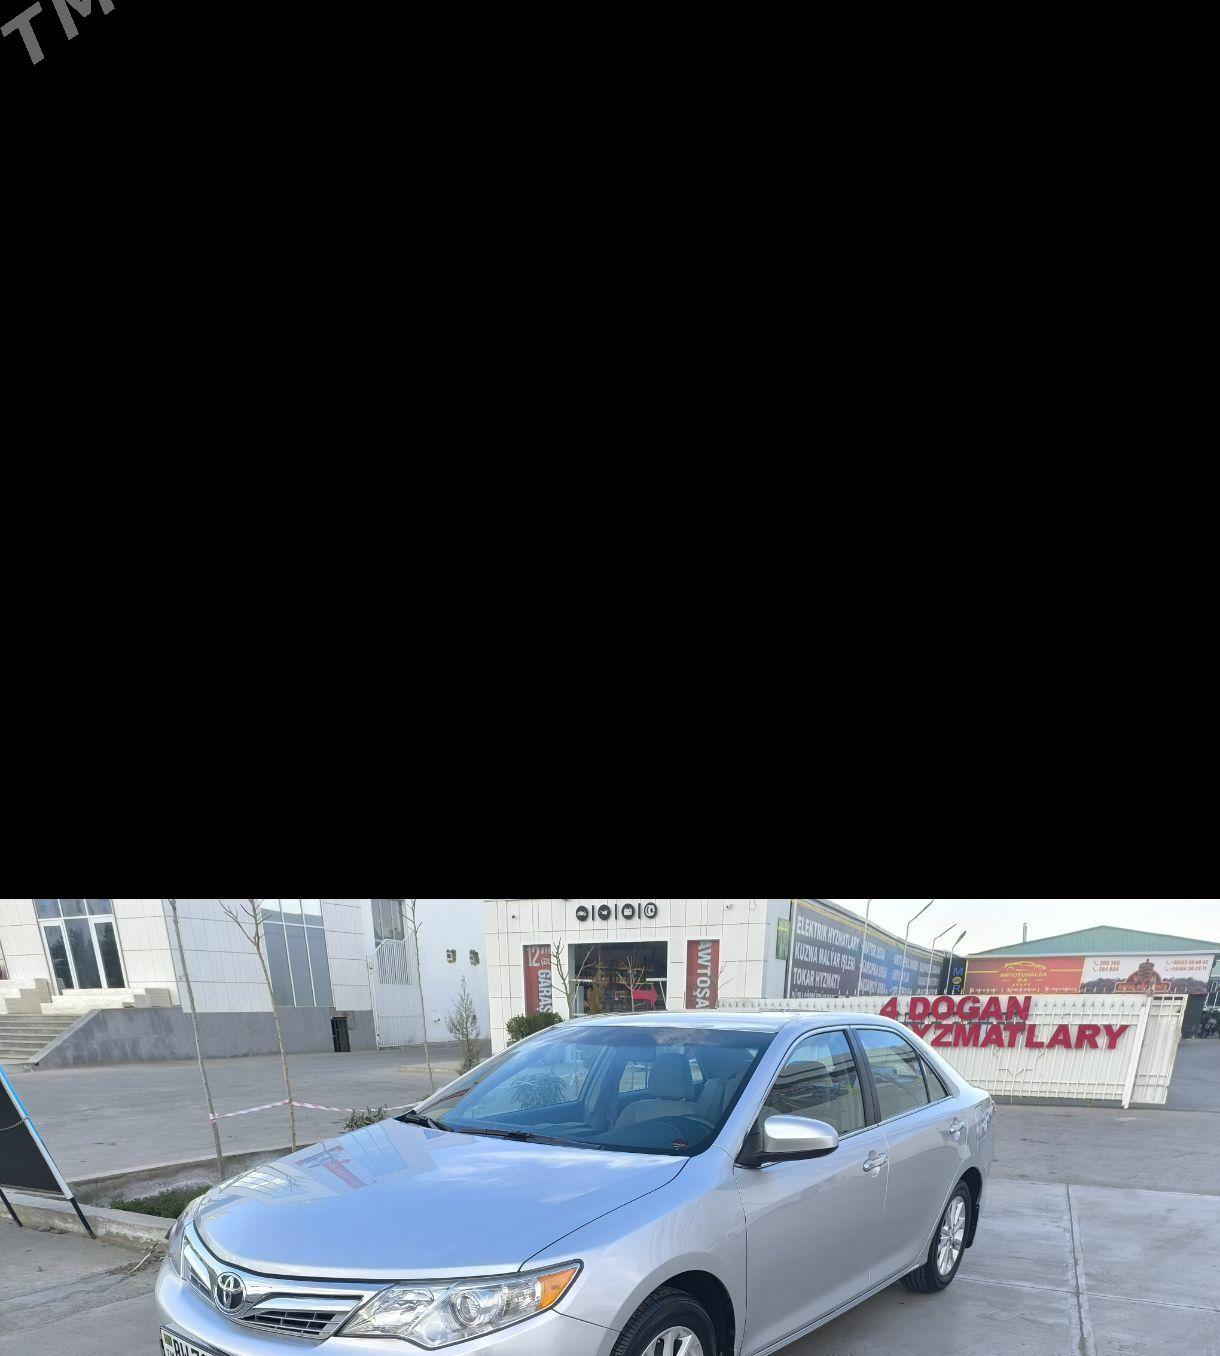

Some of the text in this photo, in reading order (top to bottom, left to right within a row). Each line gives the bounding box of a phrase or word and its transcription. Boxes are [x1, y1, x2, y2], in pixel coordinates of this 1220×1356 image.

[796, 915, 828, 942] ELEKTRIK
[794, 941, 818, 964] KUZWA
[793, 967, 815, 987] TOKAR
[879, 995, 1032, 1021] 4 DOGAN
[904, 1023, 1131, 1049] YZMATLARY
